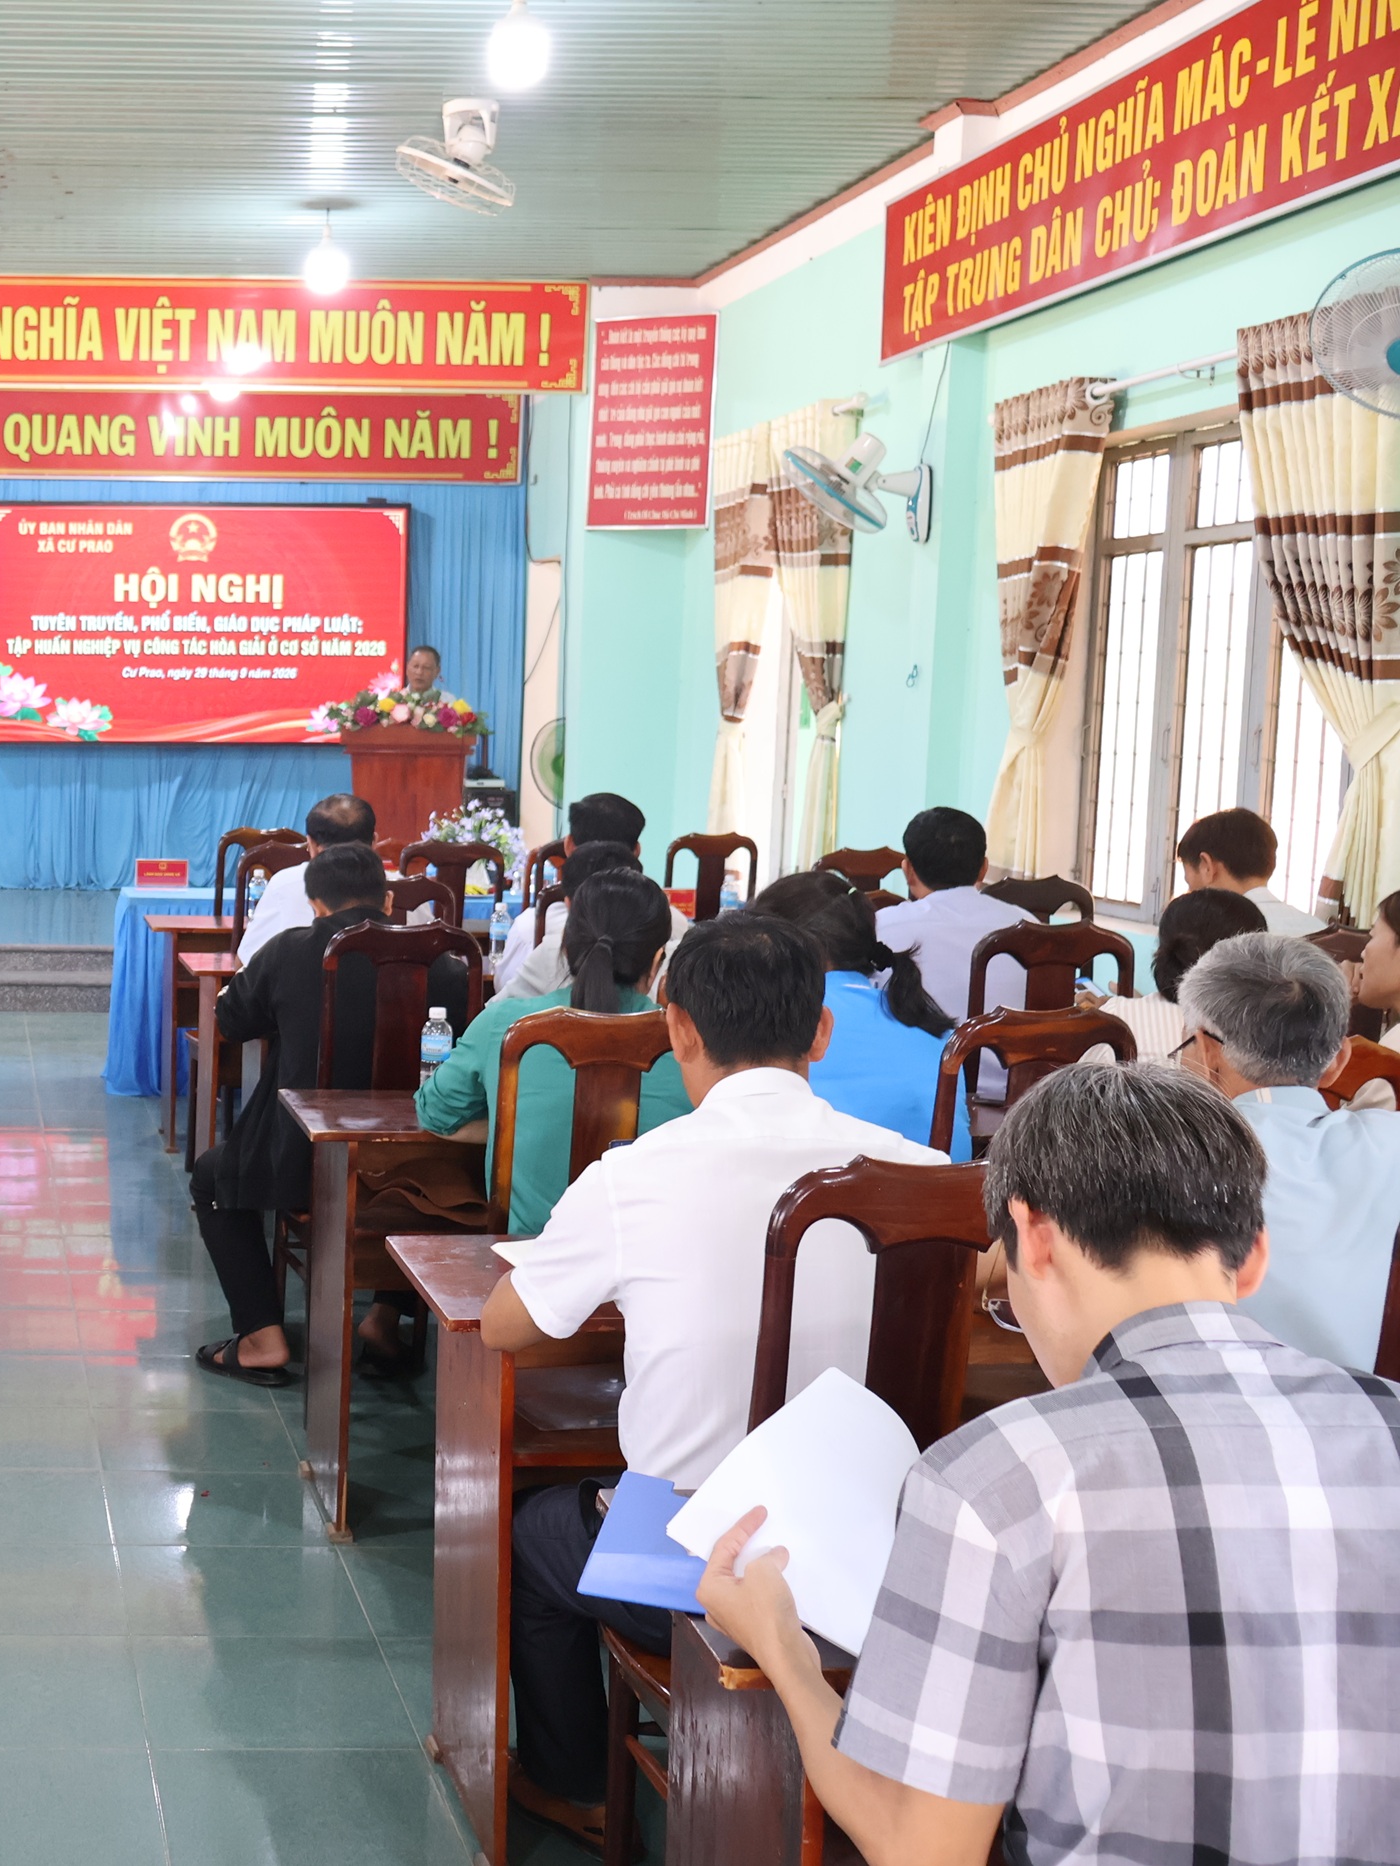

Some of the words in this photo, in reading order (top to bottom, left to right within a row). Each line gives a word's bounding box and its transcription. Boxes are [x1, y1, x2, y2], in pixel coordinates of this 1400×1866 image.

[903, 199, 951, 266] KIÊN
[957, 162, 1011, 245] ĐỊNH
[1017, 116, 1069, 211] CHỦ
[1074, 76, 1164, 184] NGHĨA
[903, 265, 938, 342] TẬP
[946, 236, 1022, 316] TRUNG
[1029, 206, 1083, 284] DÂN
[1094, 159, 1161, 259] CHỦ;
[1171, 124, 1267, 227] ĐOÀN
[1280, 69, 1357, 183] KẾT
[115, 296, 196, 374] VIỆT
[207, 308, 297, 364] NAM
[309, 299, 424, 365] MUÔN
[436, 300, 526, 366] NĂM
[3, 413, 136, 462] QUANG
[148, 415, 240, 457] VINH
[254, 406, 371, 459] MUÔN
[383, 410, 472, 459] NĂM
[39, 522, 66, 535] BAN
[68, 519, 104, 535] NHÂN
[107, 519, 133, 535] DÂN
[37, 537, 55, 553] XÃ
[57, 539, 77, 553] CƯ
[79, 540, 114, 553] PRAO
[114, 566, 179, 609] HỘI
[191, 573, 284, 609] NGHỊ
[31, 612, 77, 632] TUYÊN
[141, 610, 171, 632] PHỔ
[214, 613, 248, 633] GIÁO
[250, 615, 281, 635] DỤC
[283, 612, 321, 633] PHÁP
[6, 635, 32, 658] TẬP
[34, 634, 71, 655] HUẤN
[73, 636, 121, 658] NGHIỆP
[123, 639, 142, 658] VỤ
[143, 636, 180, 655] CÔNG
[182, 636, 207, 656] TÁC
[209, 637, 237, 656] HÒA
[239, 635, 266, 656] GIẢI
[267, 634, 280, 656] Ở
[280, 639, 299, 656] CƠ
[300, 634, 320, 656] SỞ
[321, 636, 352, 656] NĂM
[167, 667, 193, 680] ngày
[208, 667, 239, 681] tháng
[248, 668, 271, 678] năm
